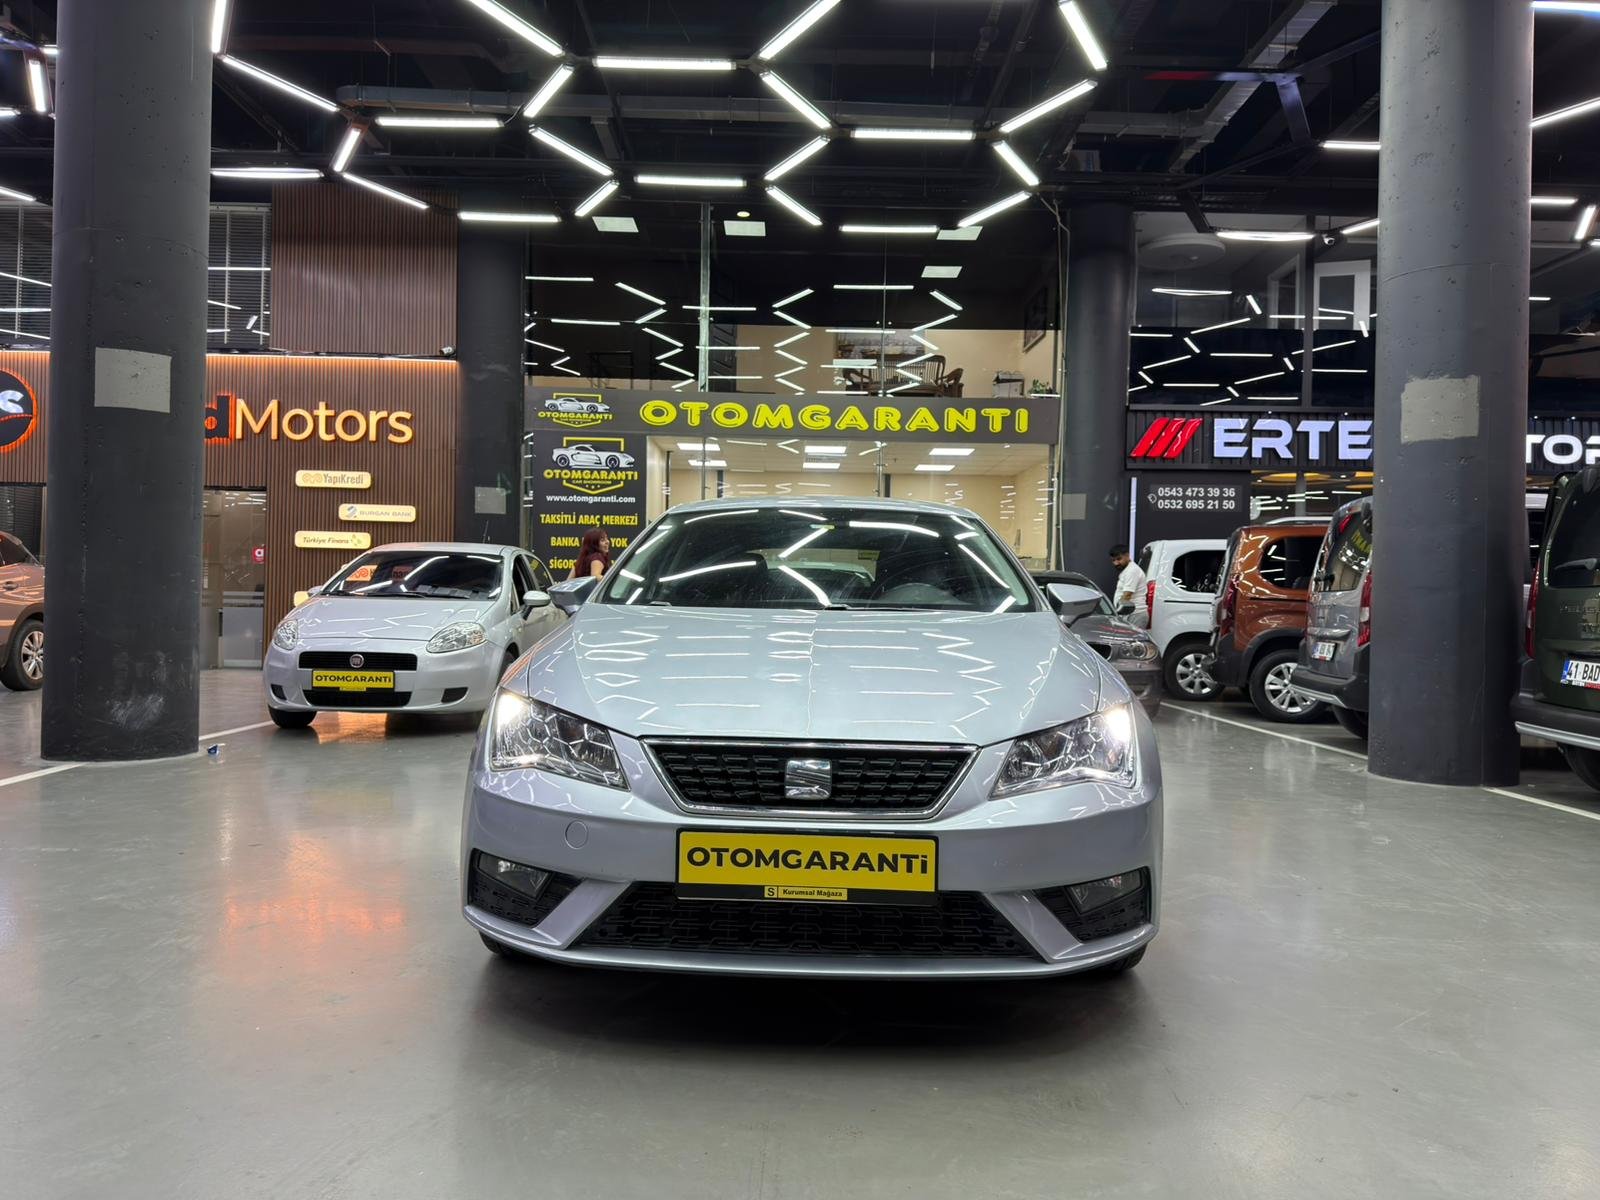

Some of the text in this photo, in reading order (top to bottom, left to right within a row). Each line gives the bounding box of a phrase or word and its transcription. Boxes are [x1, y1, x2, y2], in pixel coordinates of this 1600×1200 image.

[538, 411, 613, 419] OTOMGARANTI
[640, 400, 1029, 433] OTOMGARANTI
[1214, 418, 1373, 460] ERTE
[543, 469, 639, 480] OTOMGARANTI
[1158, 487, 1235, 498] 0543 473 39 36
[546, 495, 636, 503] www.otomgaranti.com
[1158, 499, 1235, 510] 0532 695 21 50
[540, 512, 638, 527] TAKSİTLİ ARAÇ MERKEZİ
[550, 536, 580, 547] BANKA
[610, 538, 628, 548] YOK
[782, 888, 843, 898] Kurumsal Mağaza
